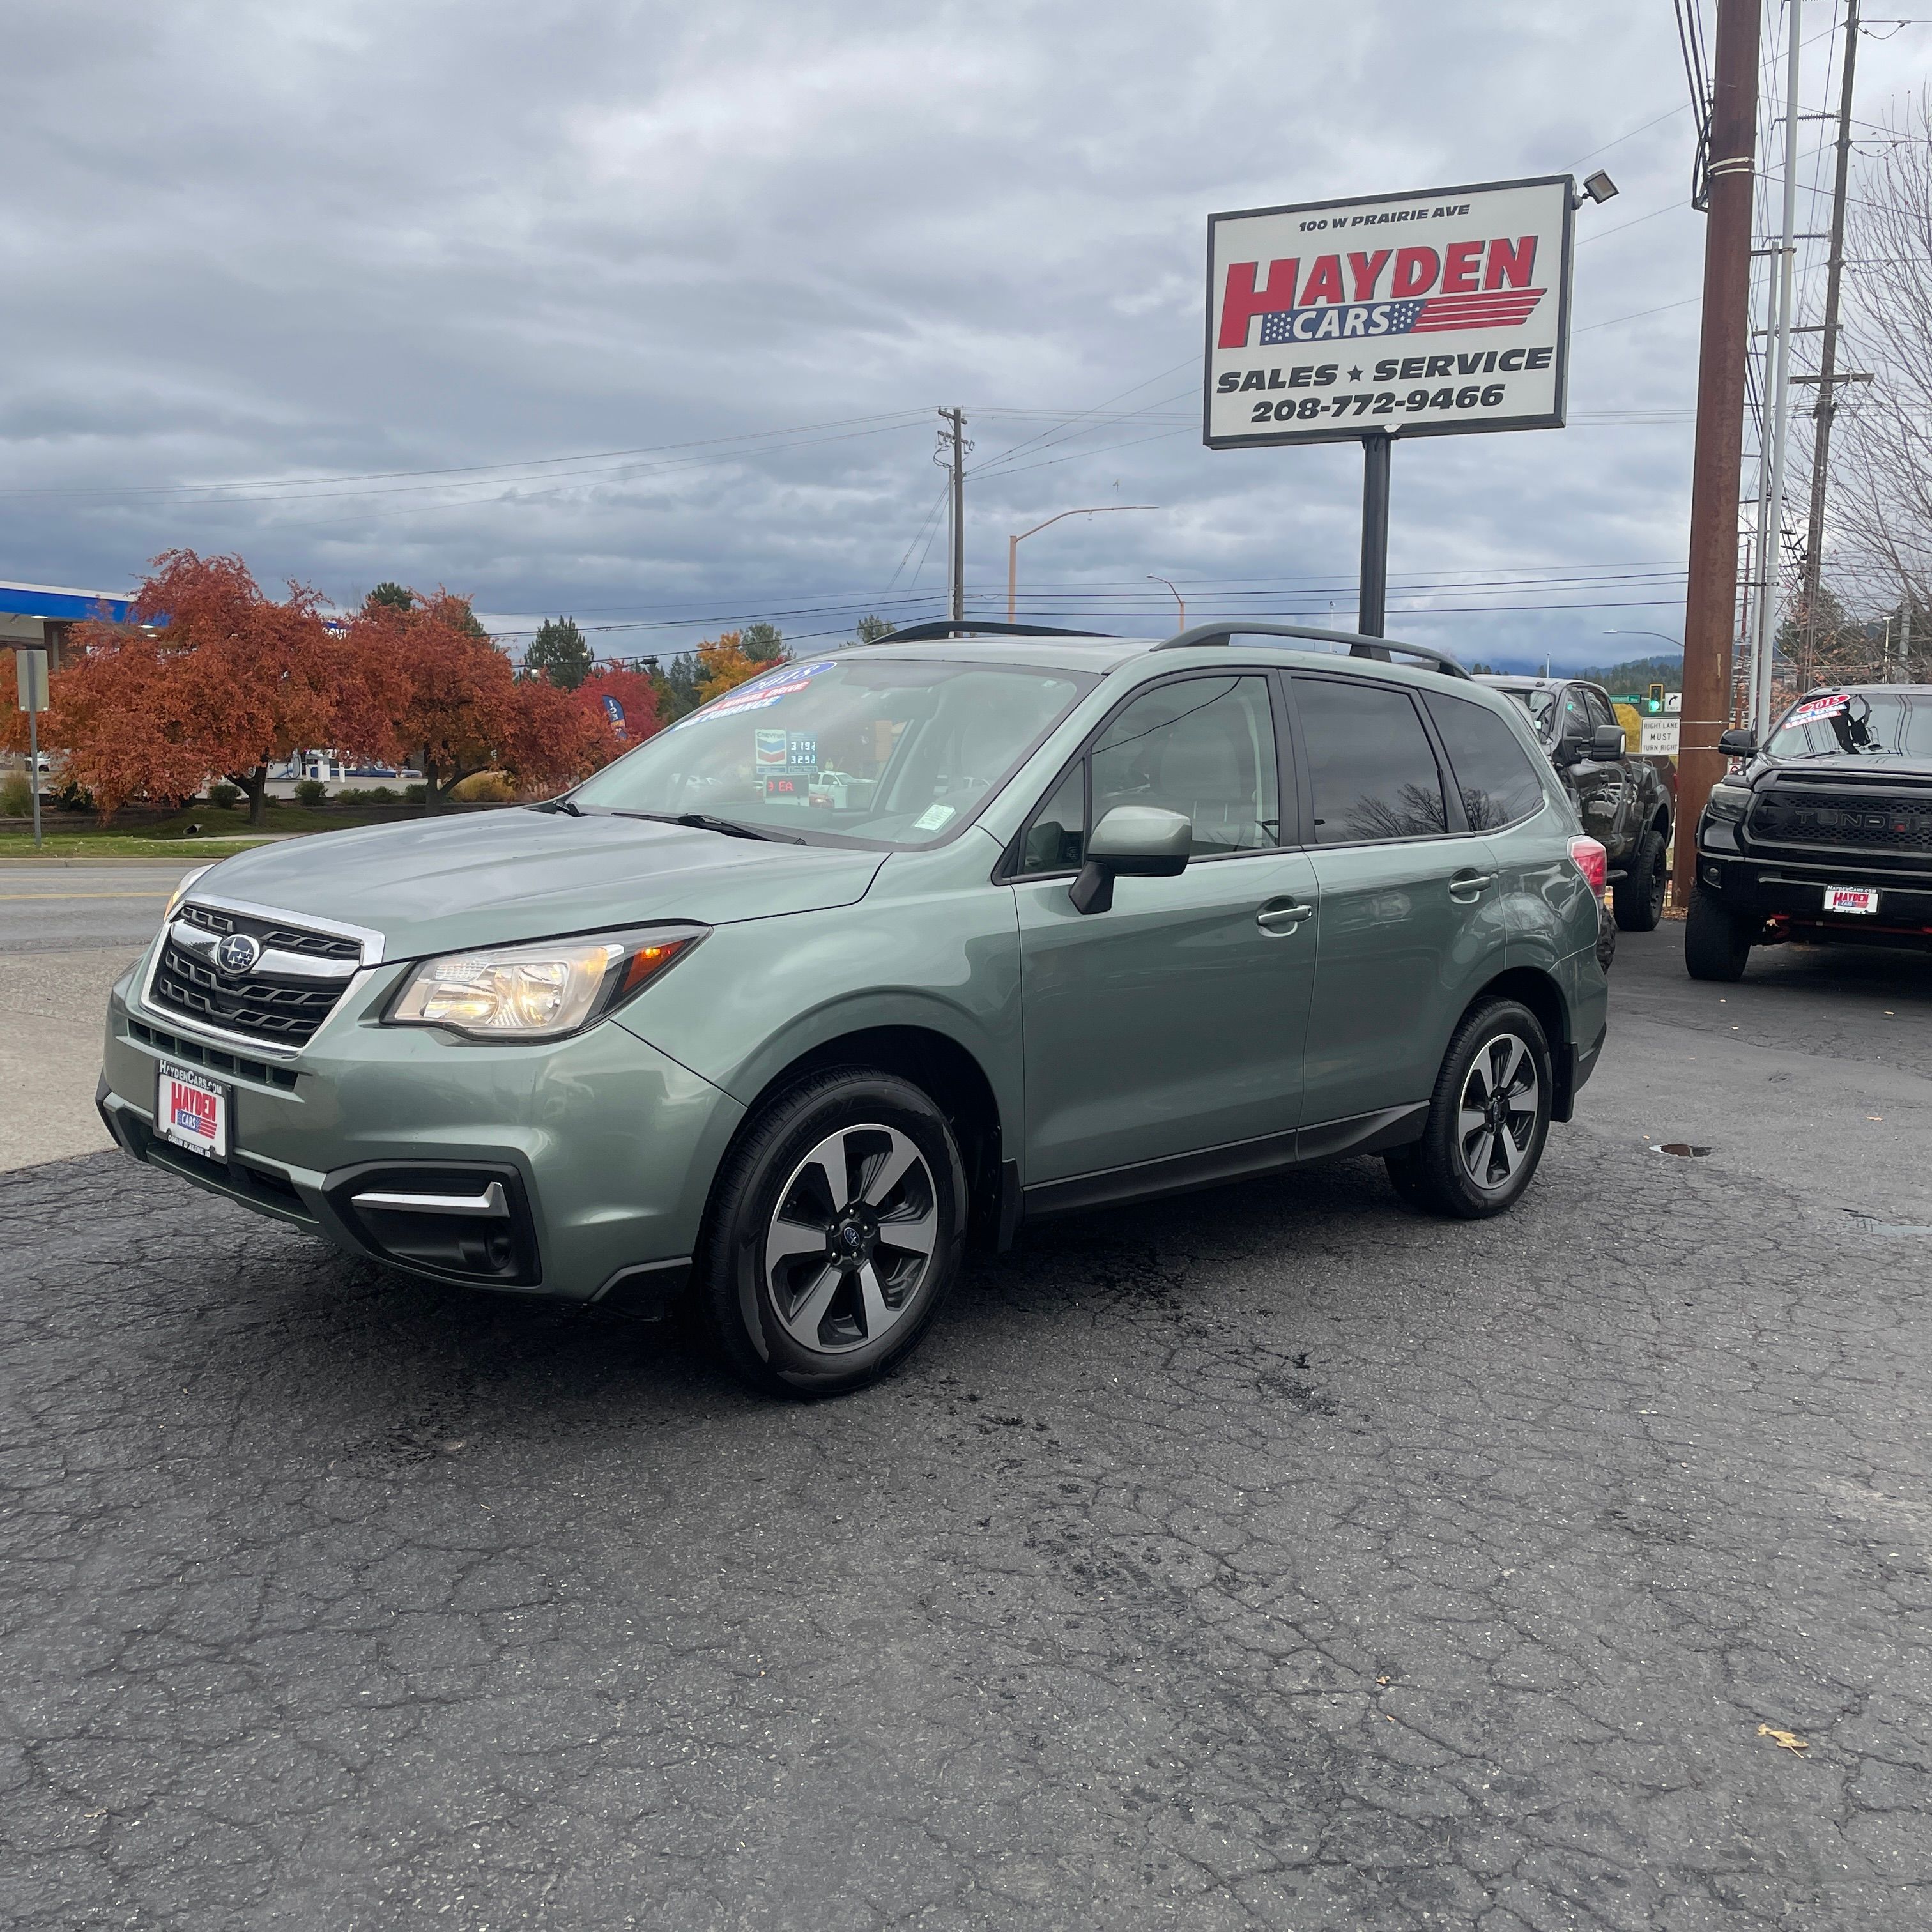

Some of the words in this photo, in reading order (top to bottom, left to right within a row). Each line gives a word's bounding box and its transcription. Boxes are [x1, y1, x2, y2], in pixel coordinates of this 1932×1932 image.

[1300, 220, 1328, 232] 100
[1332, 217, 1348, 228] W
[1351, 209, 1429, 227] PRAIRIE
[1431, 204, 1470, 218] AVE
[1218, 235, 1538, 349] HAYDEN
[1292, 305, 1393, 341] CARS
[1216, 364, 1338, 393] SALES
[1372, 346, 1553, 381] SERVICE
[1251, 384, 1505, 423] 208-772-9466
[736, 665, 820, 696] 2018
[765, 680, 811, 697] DRIVE
[1810, 697, 1839, 710] 2015
[1833, 892, 1869, 905] HAYDEN
[171, 1081, 217, 1123] HAYDEN
[182, 1114, 195, 1129] CARS
